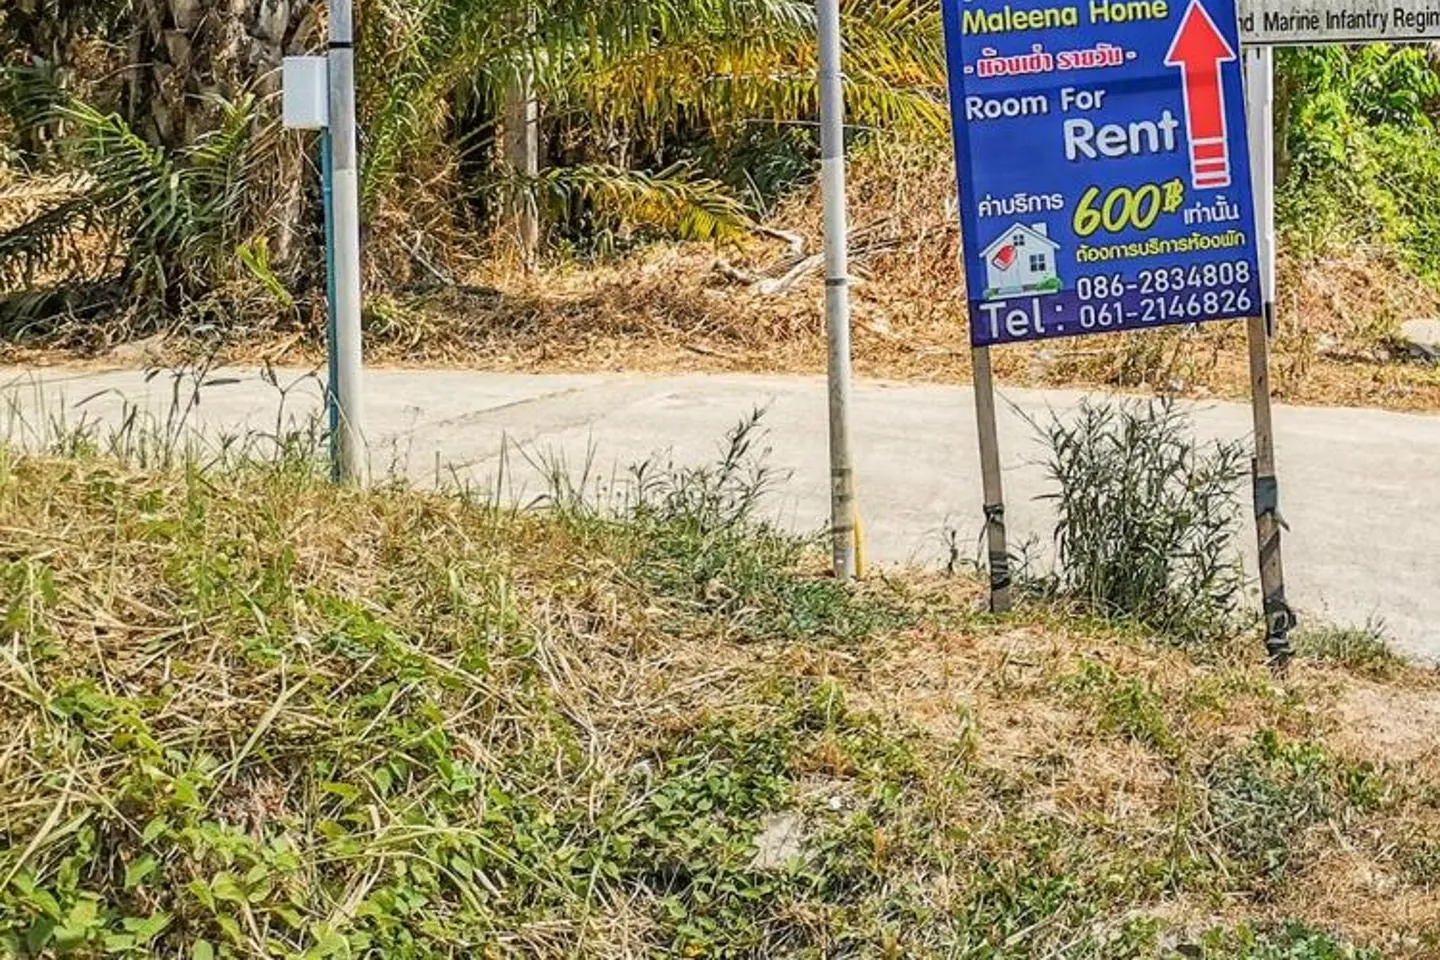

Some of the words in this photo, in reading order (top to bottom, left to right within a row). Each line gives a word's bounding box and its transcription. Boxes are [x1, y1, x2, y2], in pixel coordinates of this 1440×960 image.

[961, 5, 1078, 35] Maleena
[1089, 0, 1168, 25] Home
[1264, 8, 1320, 32] Marine
[1326, 7, 1388, 35] Infantry
[966, 92, 1048, 121] Room
[1061, 87, 1106, 111] For
[1063, 109, 1179, 161] Rent
[978, 192, 1065, 218] ค่าบริการ
[1183, 196, 1240, 225] เท่านั้น
[1076, 261, 1251, 301] 086-2834808
[1079, 291, 1252, 329] 061-2146826
